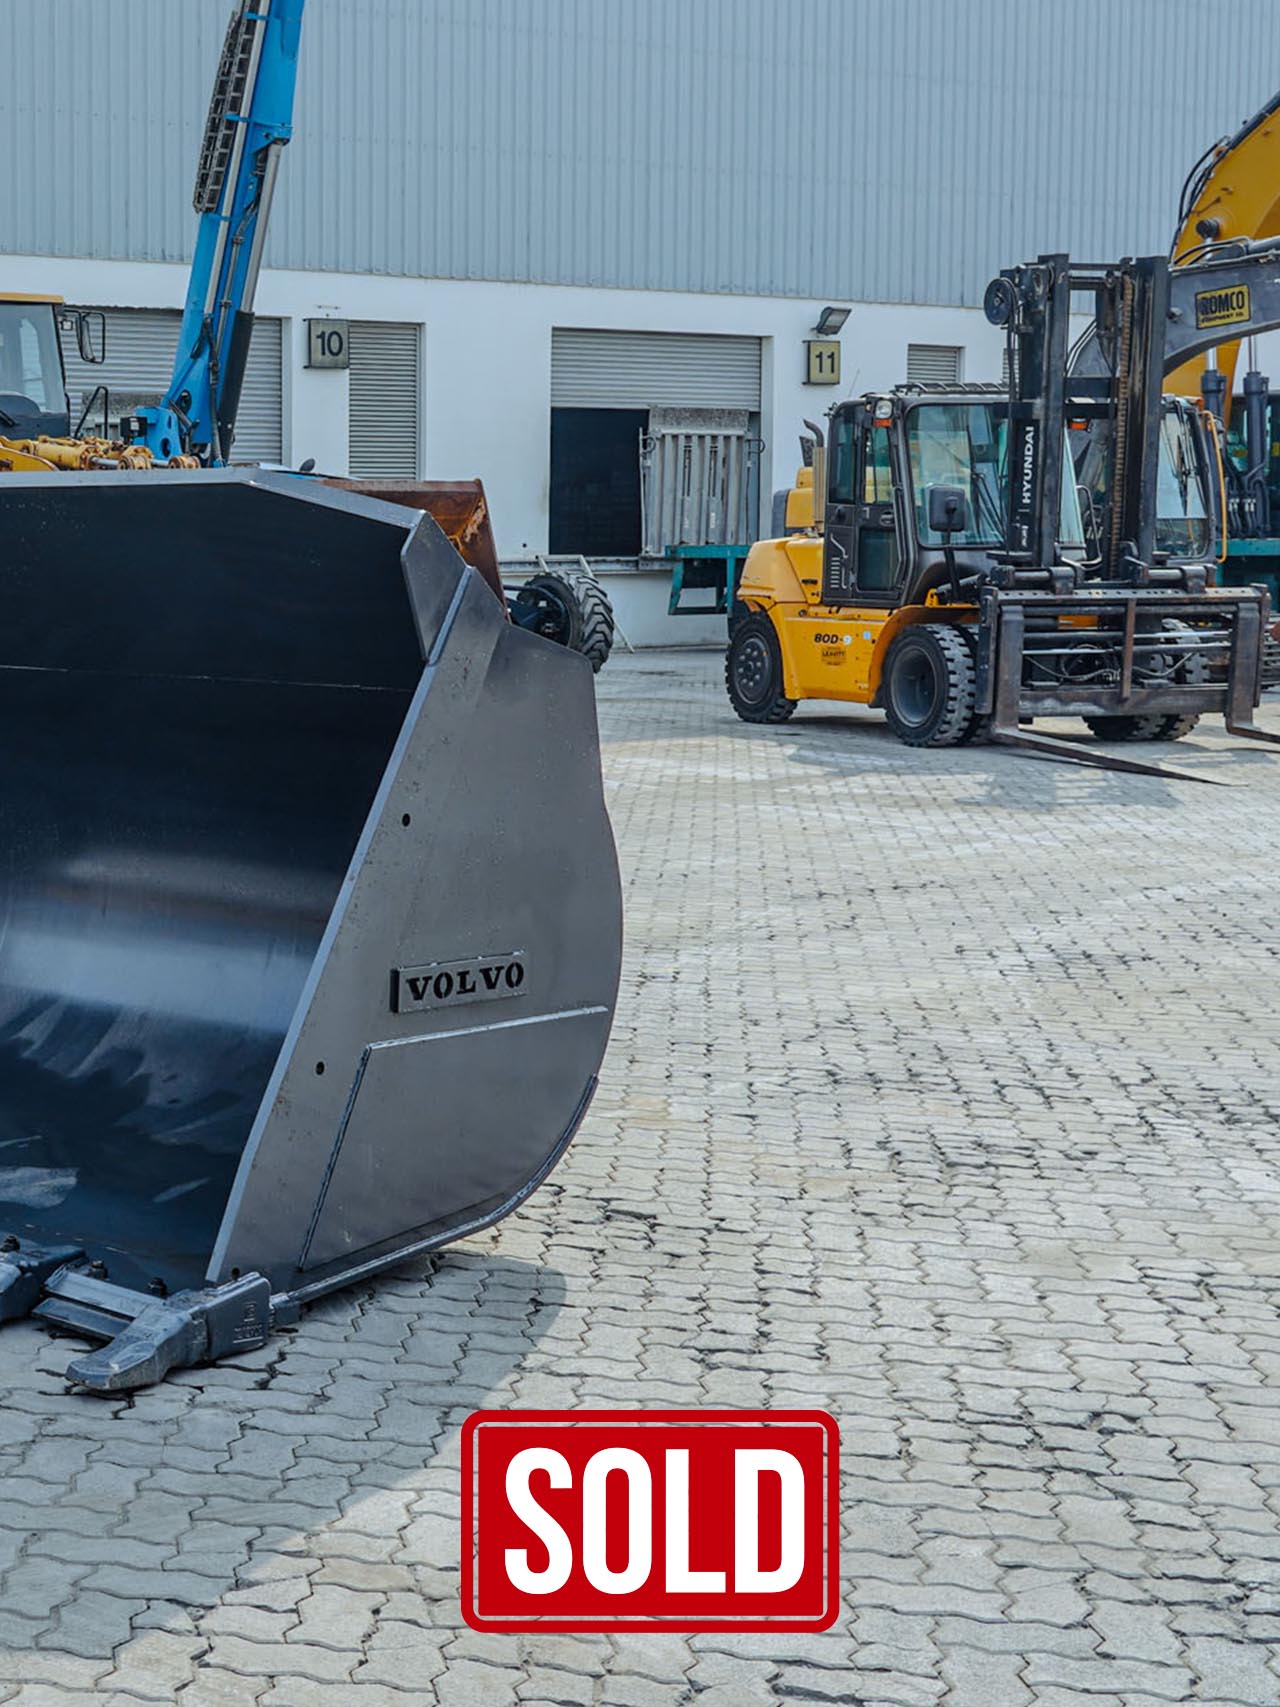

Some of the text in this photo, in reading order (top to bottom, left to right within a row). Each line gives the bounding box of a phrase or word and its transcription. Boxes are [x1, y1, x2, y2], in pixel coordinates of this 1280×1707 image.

[1200, 291, 1245, 315] ROMCO
[316, 331, 343, 357] 10
[815, 351, 835, 374] 11
[1022, 426, 1035, 504] HYUNDAI
[406, 962, 525, 1001] VOLVO
